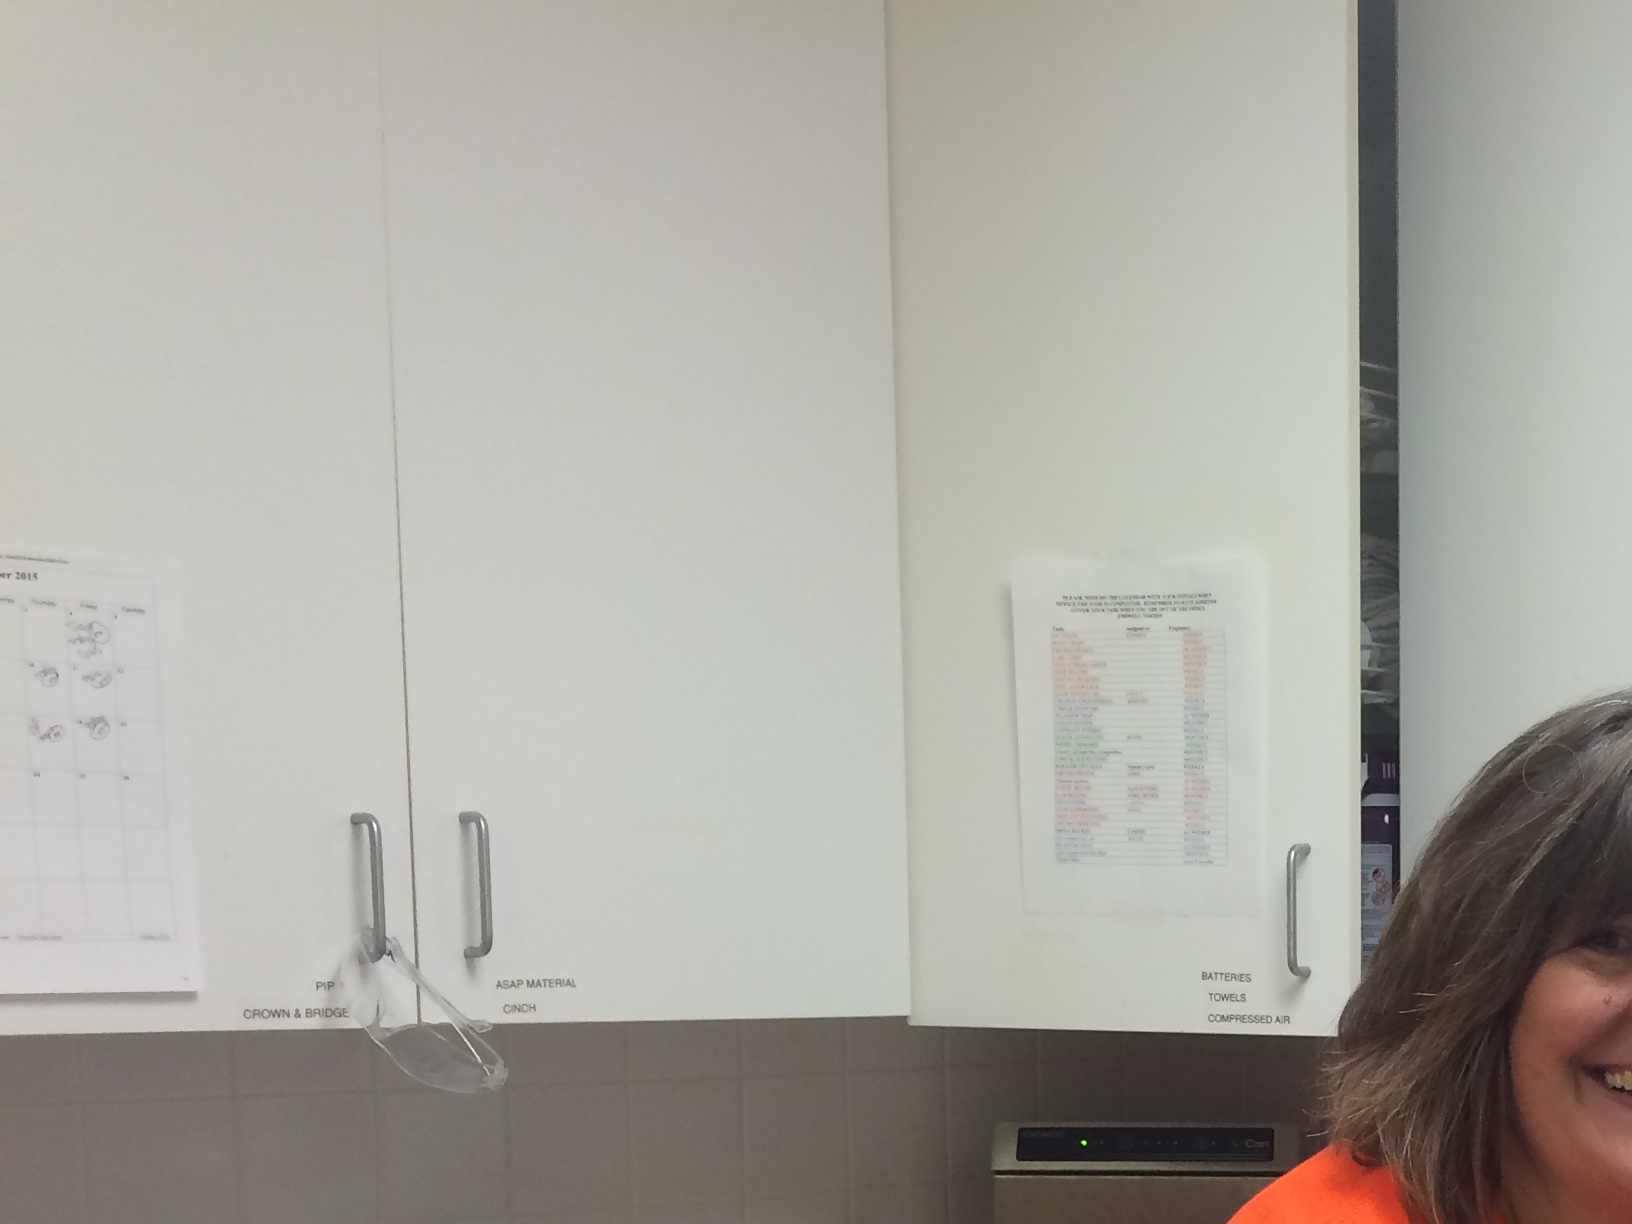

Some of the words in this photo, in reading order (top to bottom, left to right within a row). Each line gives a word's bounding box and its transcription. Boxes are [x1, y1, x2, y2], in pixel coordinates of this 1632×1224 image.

[1201, 971, 1252, 983] BATTERIES
[315, 981, 335, 991] PIP
[496, 979, 524, 990] ASAP
[526, 978, 577, 988] MATERIAL
[1208, 992, 1247, 1002] TOWELS
[243, 1008, 291, 1019] CROWN
[293, 1008, 302, 1018] &
[305, 1007, 350, 1018] BRIDGE
[503, 1003, 537, 1014] CINCH
[1208, 1013, 1273, 1024] COMPRESSED
[1274, 1015, 1291, 1024] AIR
